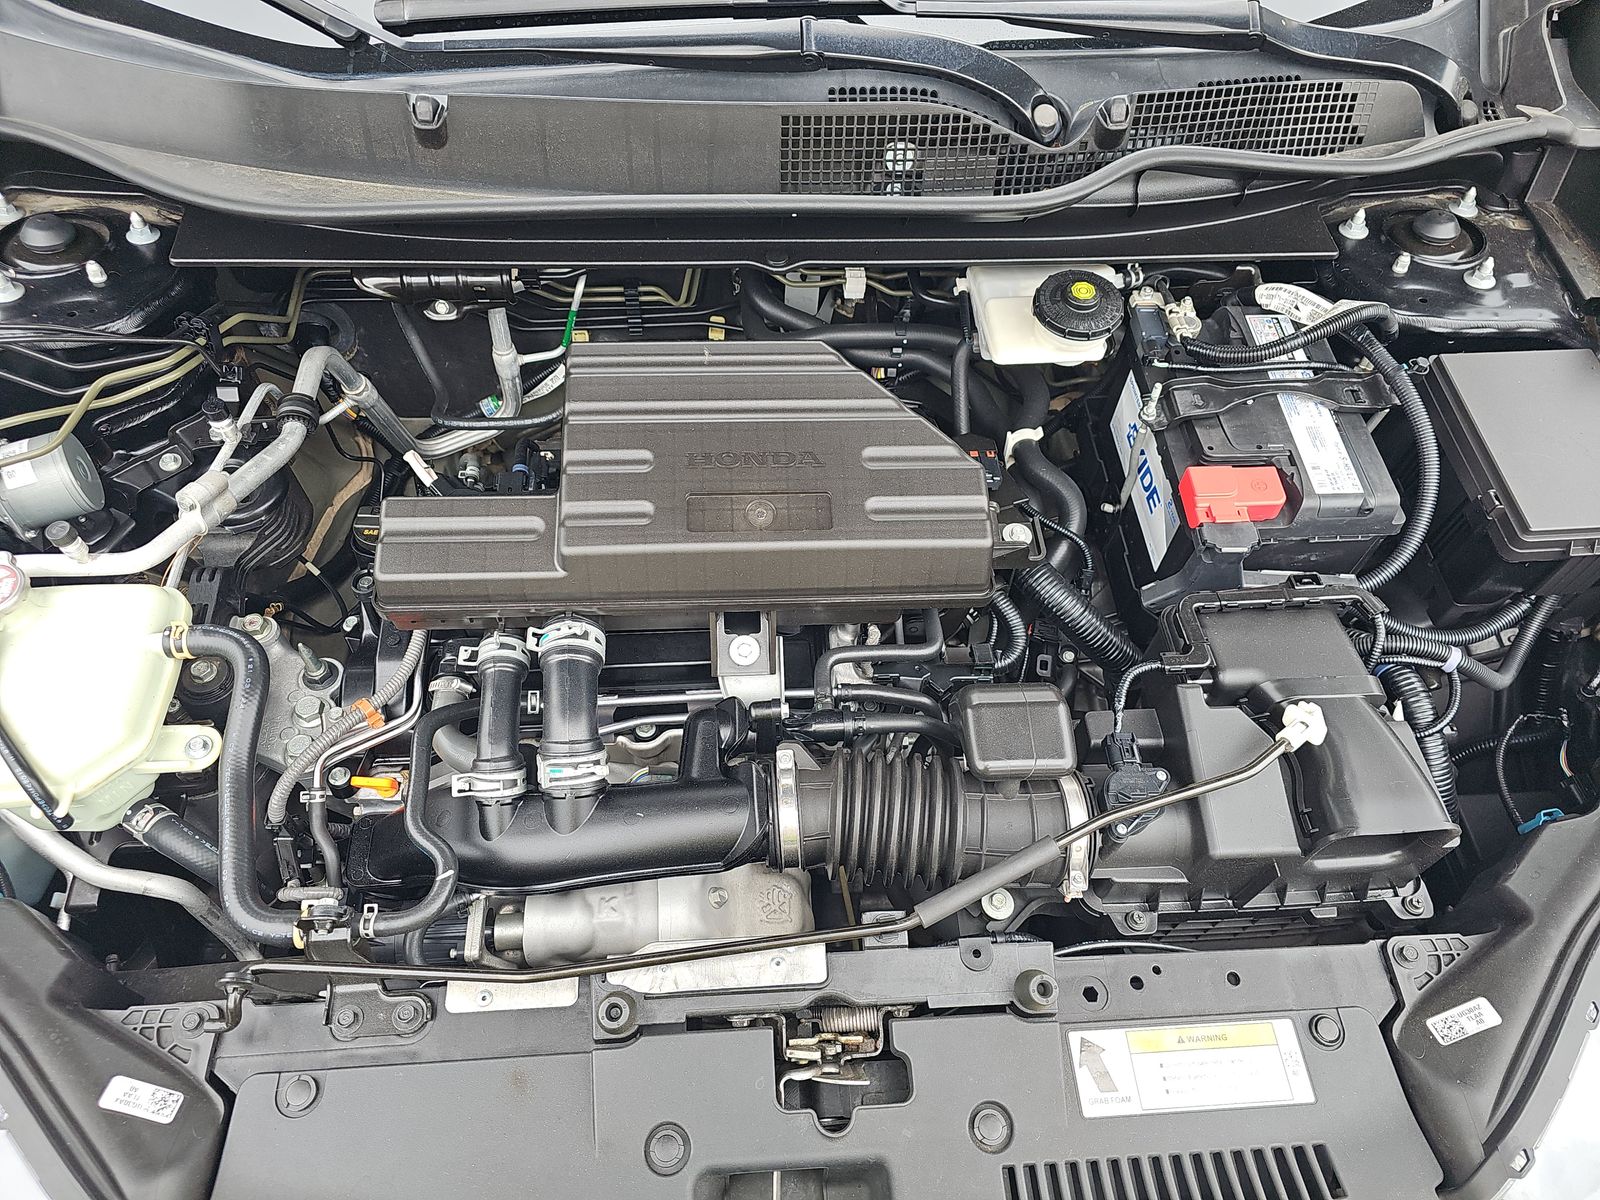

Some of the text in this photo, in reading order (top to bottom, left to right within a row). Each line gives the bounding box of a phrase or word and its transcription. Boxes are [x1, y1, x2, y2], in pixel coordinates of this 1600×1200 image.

[685, 450, 826, 468] HONDA
[1126, 422, 1162, 515] EIDE
[1186, 1033, 1229, 1043] WARNING
[1088, 1095, 1133, 1105] GRAB FOAM
